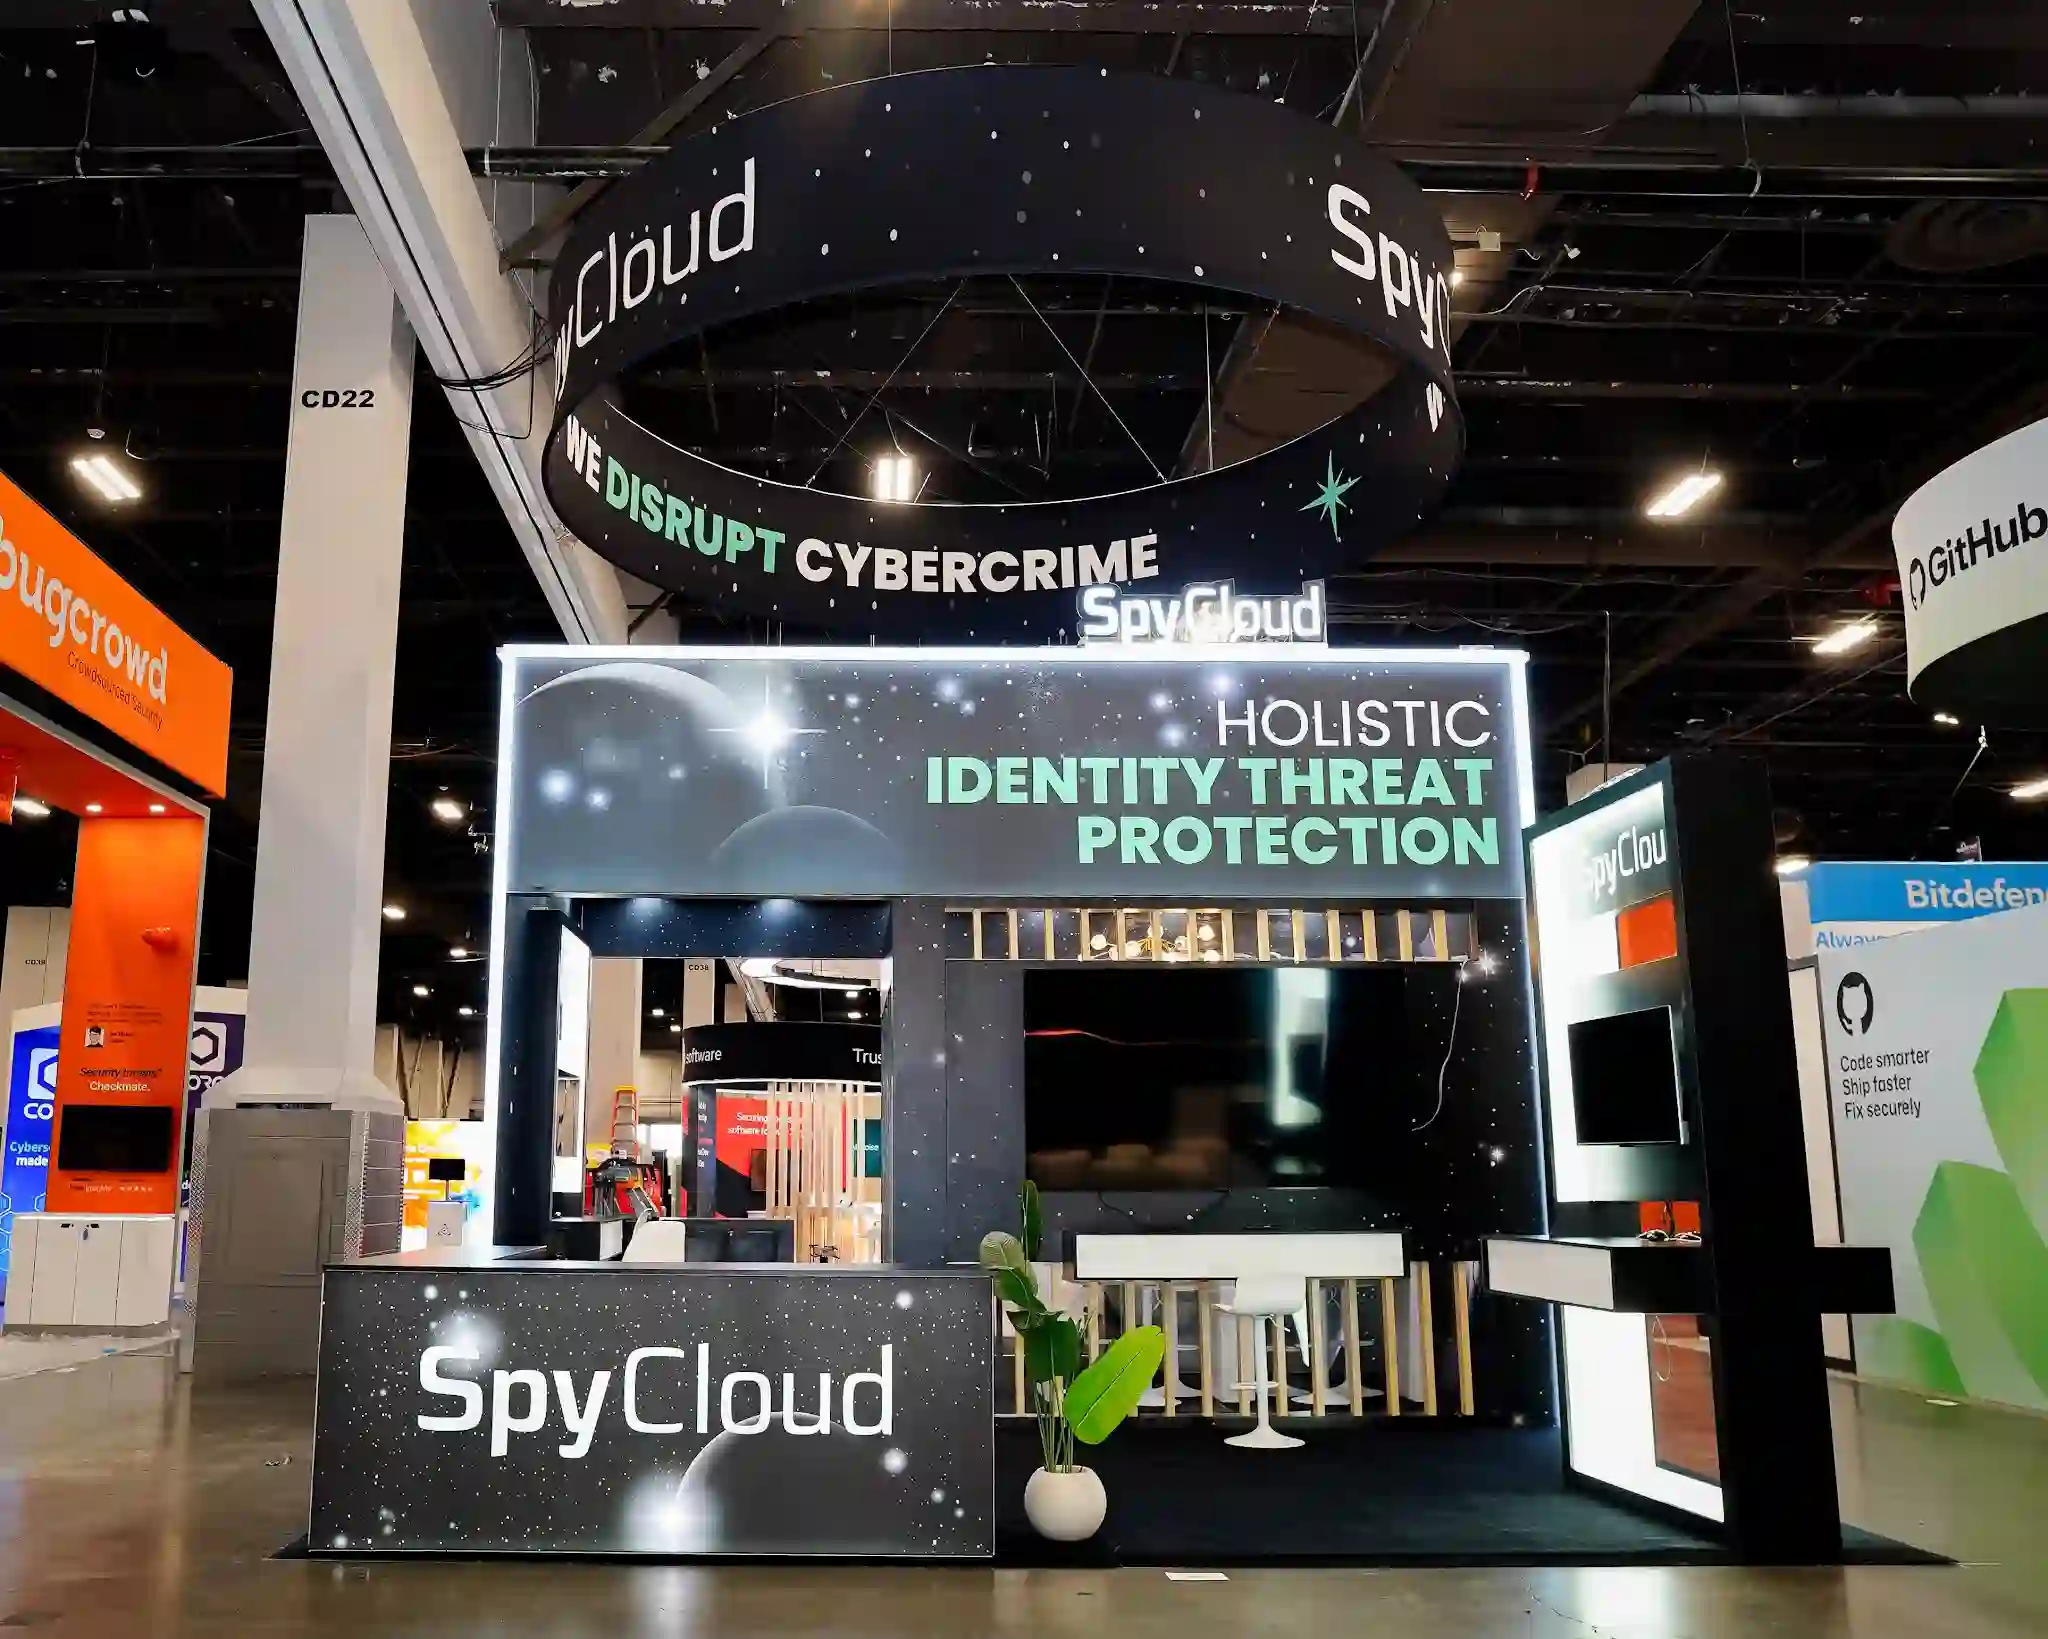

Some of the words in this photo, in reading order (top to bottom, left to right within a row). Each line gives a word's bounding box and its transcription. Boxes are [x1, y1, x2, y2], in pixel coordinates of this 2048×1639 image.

[301, 389, 375, 408] CD22
[566, 414, 602, 493] WE
[605, 456, 786, 574] DISRUPT
[796, 534, 1159, 593] CYBERCRIME
[1929, 502, 2048, 586] GitHub
[0, 515, 167, 706] bugcrowd
[1083, 585, 1323, 645] SpyCloud
[1218, 699, 1491, 748] HOLISTIC
[926, 757, 1224, 804] IDENTITY
[1239, 757, 1493, 806] THREAT
[1078, 816, 1499, 865] PROTECTION
[1904, 877, 2048, 909] Bitdefen
[1840, 1053, 1873, 1072] Code
[1876, 1047, 1930, 1068] smarter
[1842, 1077, 1871, 1097] Ship
[1873, 1073, 1912, 1093] faster
[1844, 1101, 1864, 1119] Fix
[1867, 1097, 1921, 1119] securely
[10, 1141, 50, 1154] Cybers
[417, 1342, 892, 1459] SpyCloud
